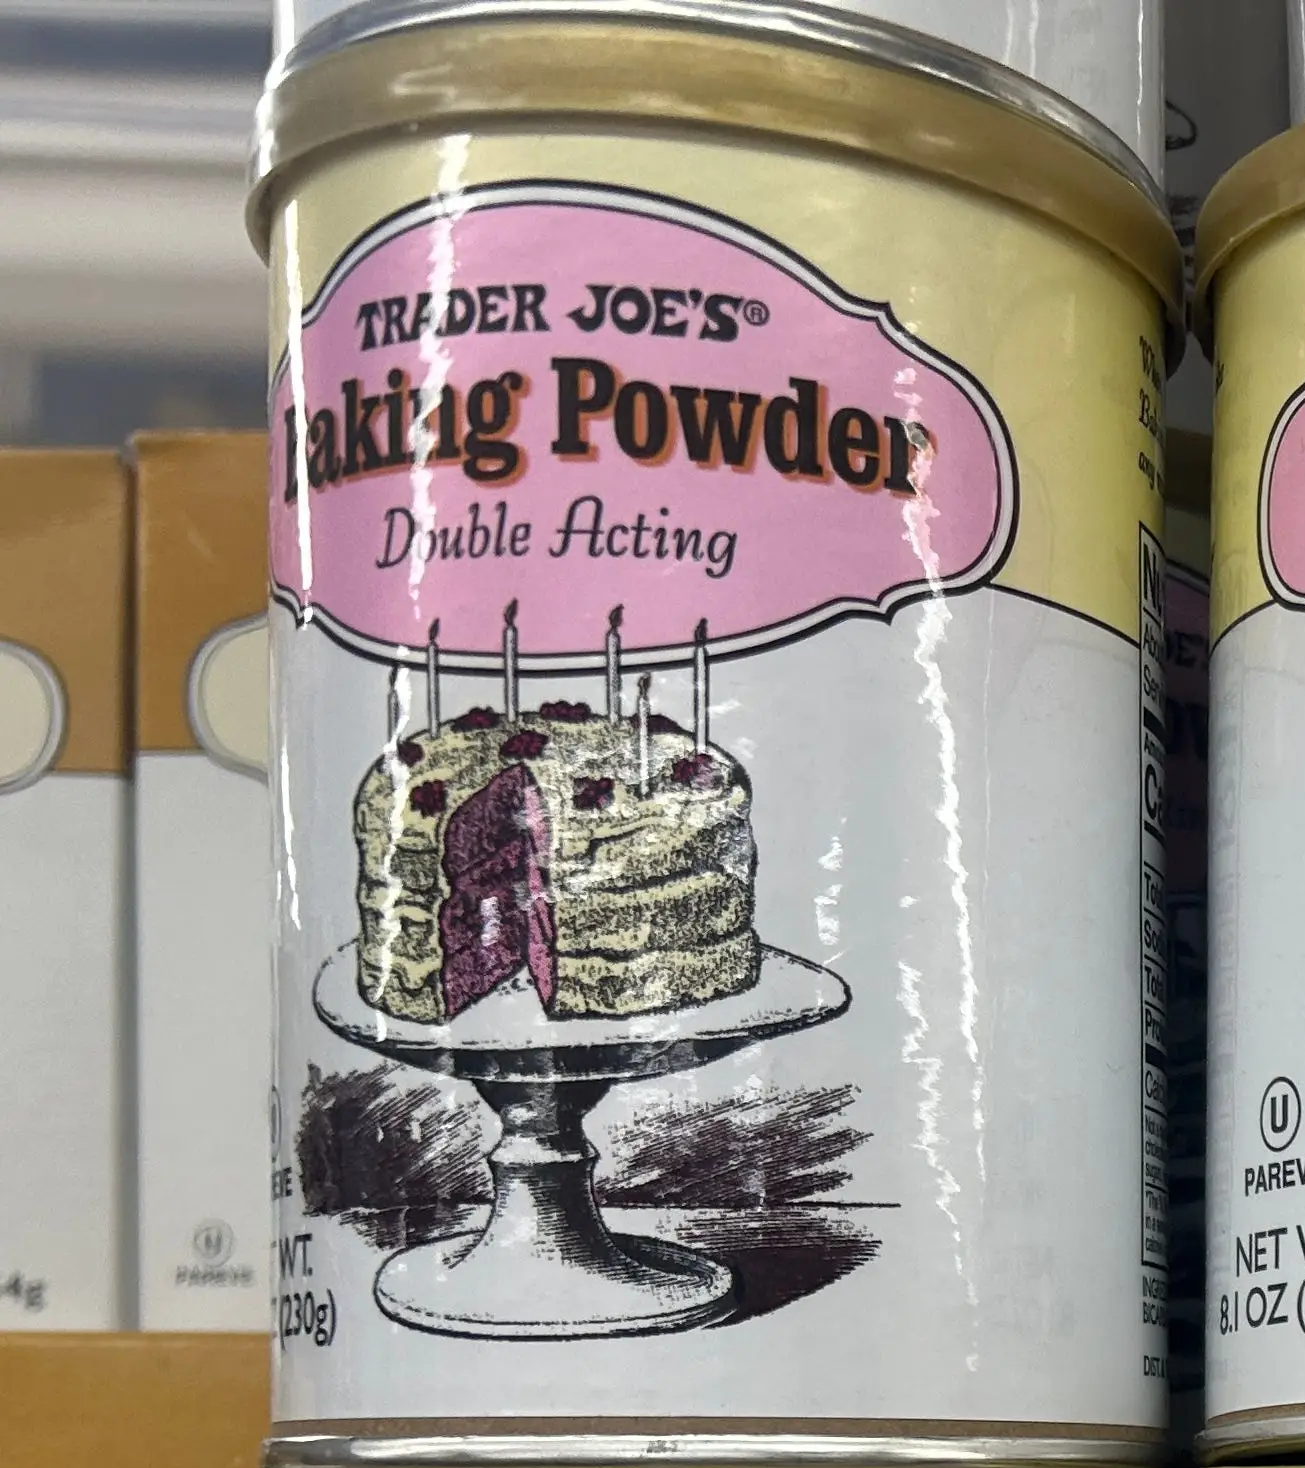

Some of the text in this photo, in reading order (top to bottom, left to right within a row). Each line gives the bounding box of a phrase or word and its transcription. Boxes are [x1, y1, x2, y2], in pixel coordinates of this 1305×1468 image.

[356, 284, 550, 351] TRADER
[551, 357, 937, 499] Powder
[376, 496, 737, 578] Double Acting
[279, 1233, 312, 1280] WT.
[1236, 1227, 1288, 1278] NET
[1219, 1290, 1239, 1336] 8.1
[1246, 1282, 1289, 1328] OZ
